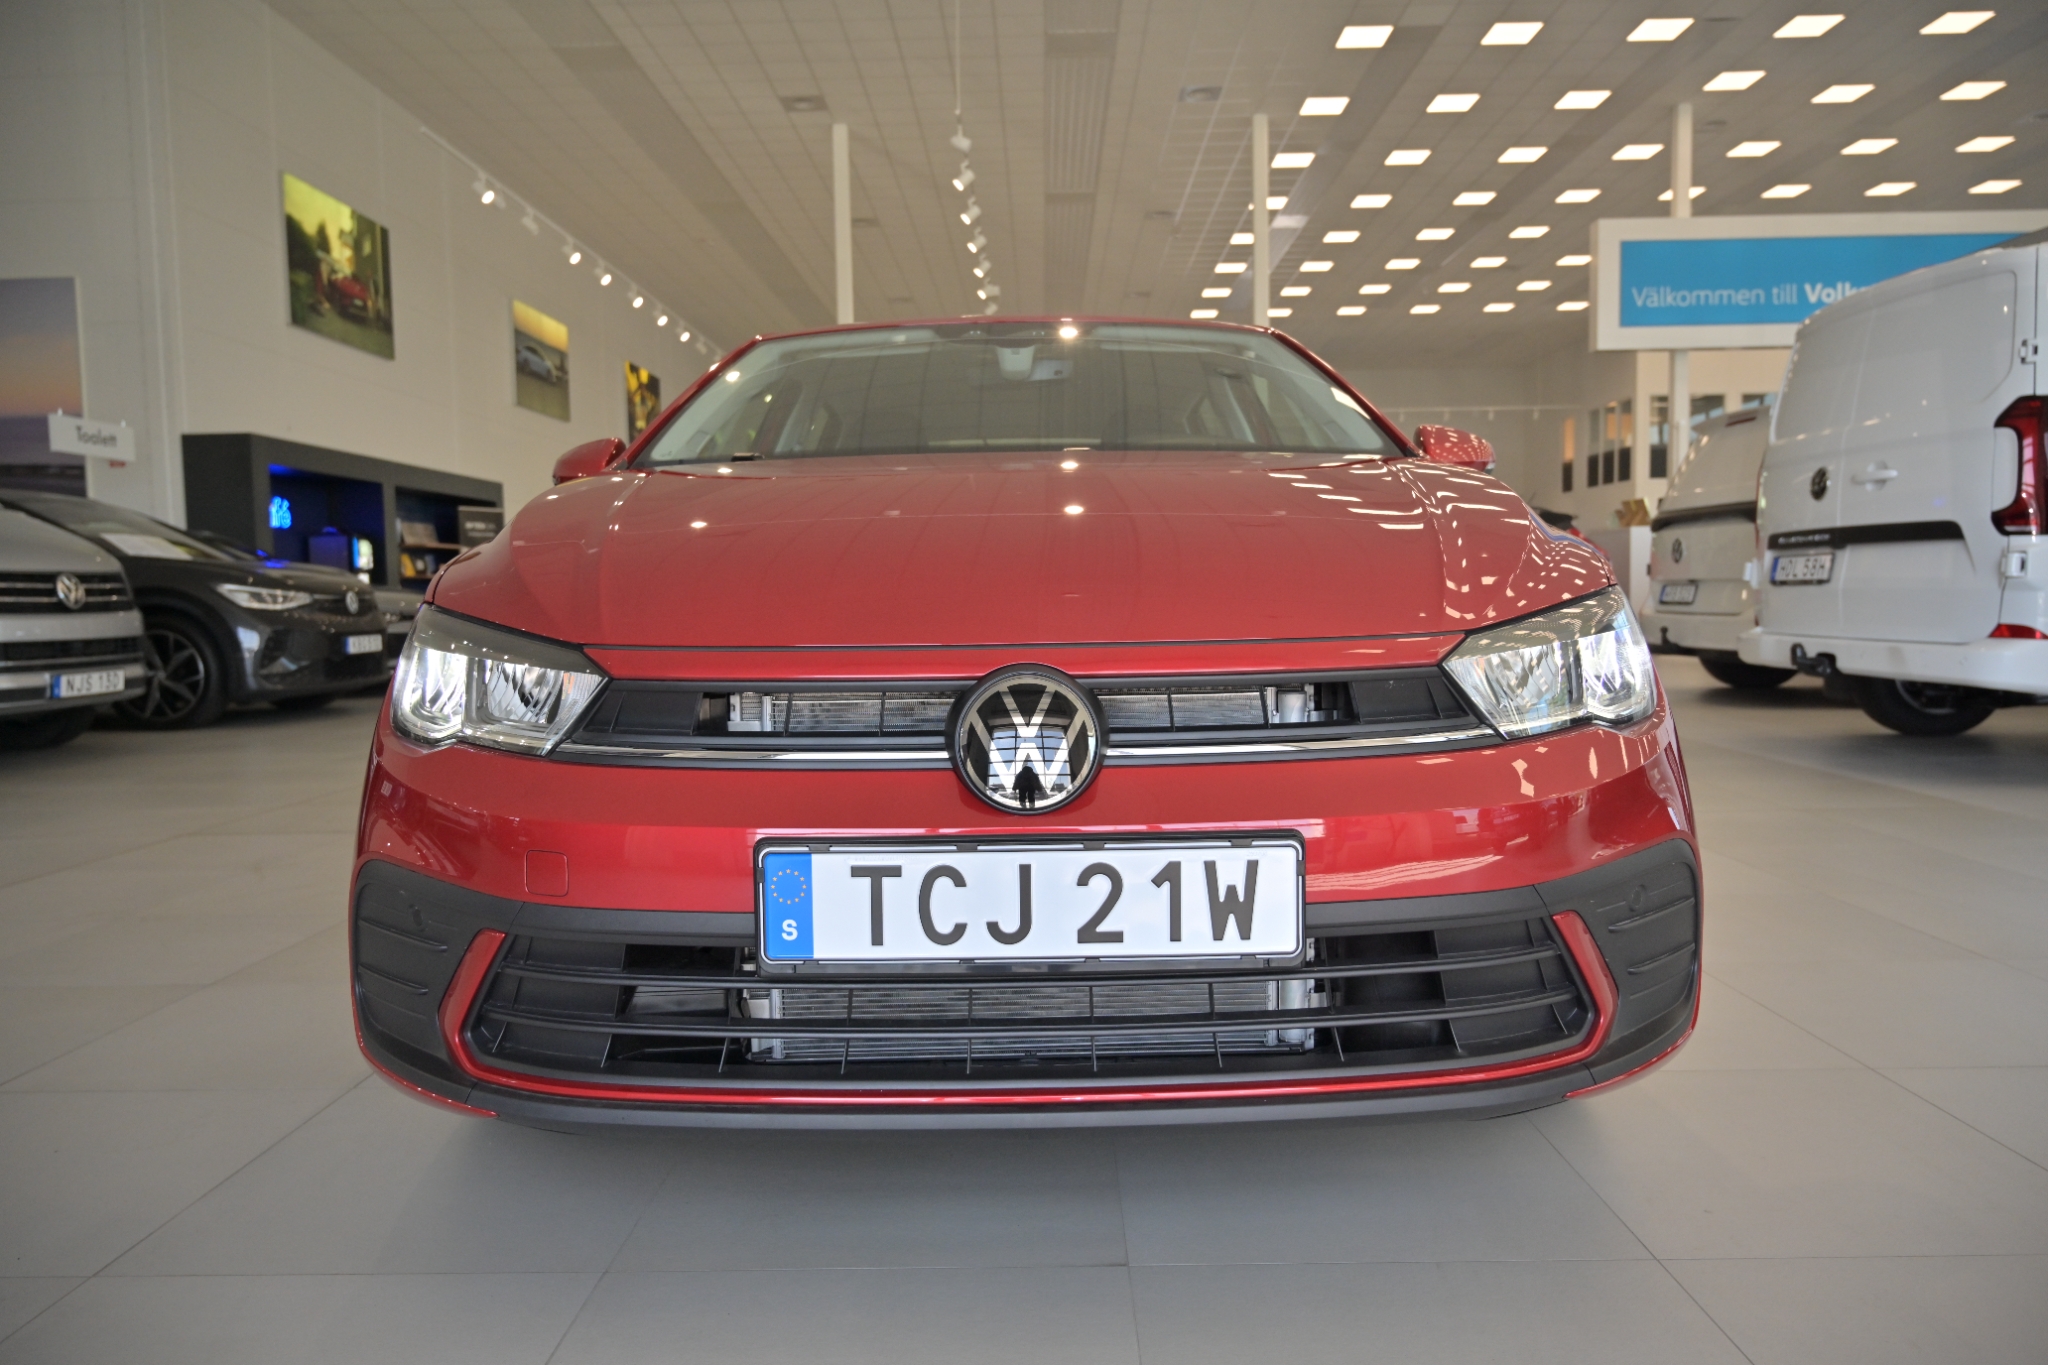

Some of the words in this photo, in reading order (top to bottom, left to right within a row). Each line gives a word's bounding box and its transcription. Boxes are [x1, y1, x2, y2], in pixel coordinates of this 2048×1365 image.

[1631, 285, 1766, 308] Välkommen
[1772, 283, 1798, 306] till
[1804, 281, 1868, 304] Volk
[75, 424, 118, 448] Toalett
[850, 862, 1033, 946] TCJ
[1076, 859, 1259, 944] 21W
[780, 918, 799, 942] S
